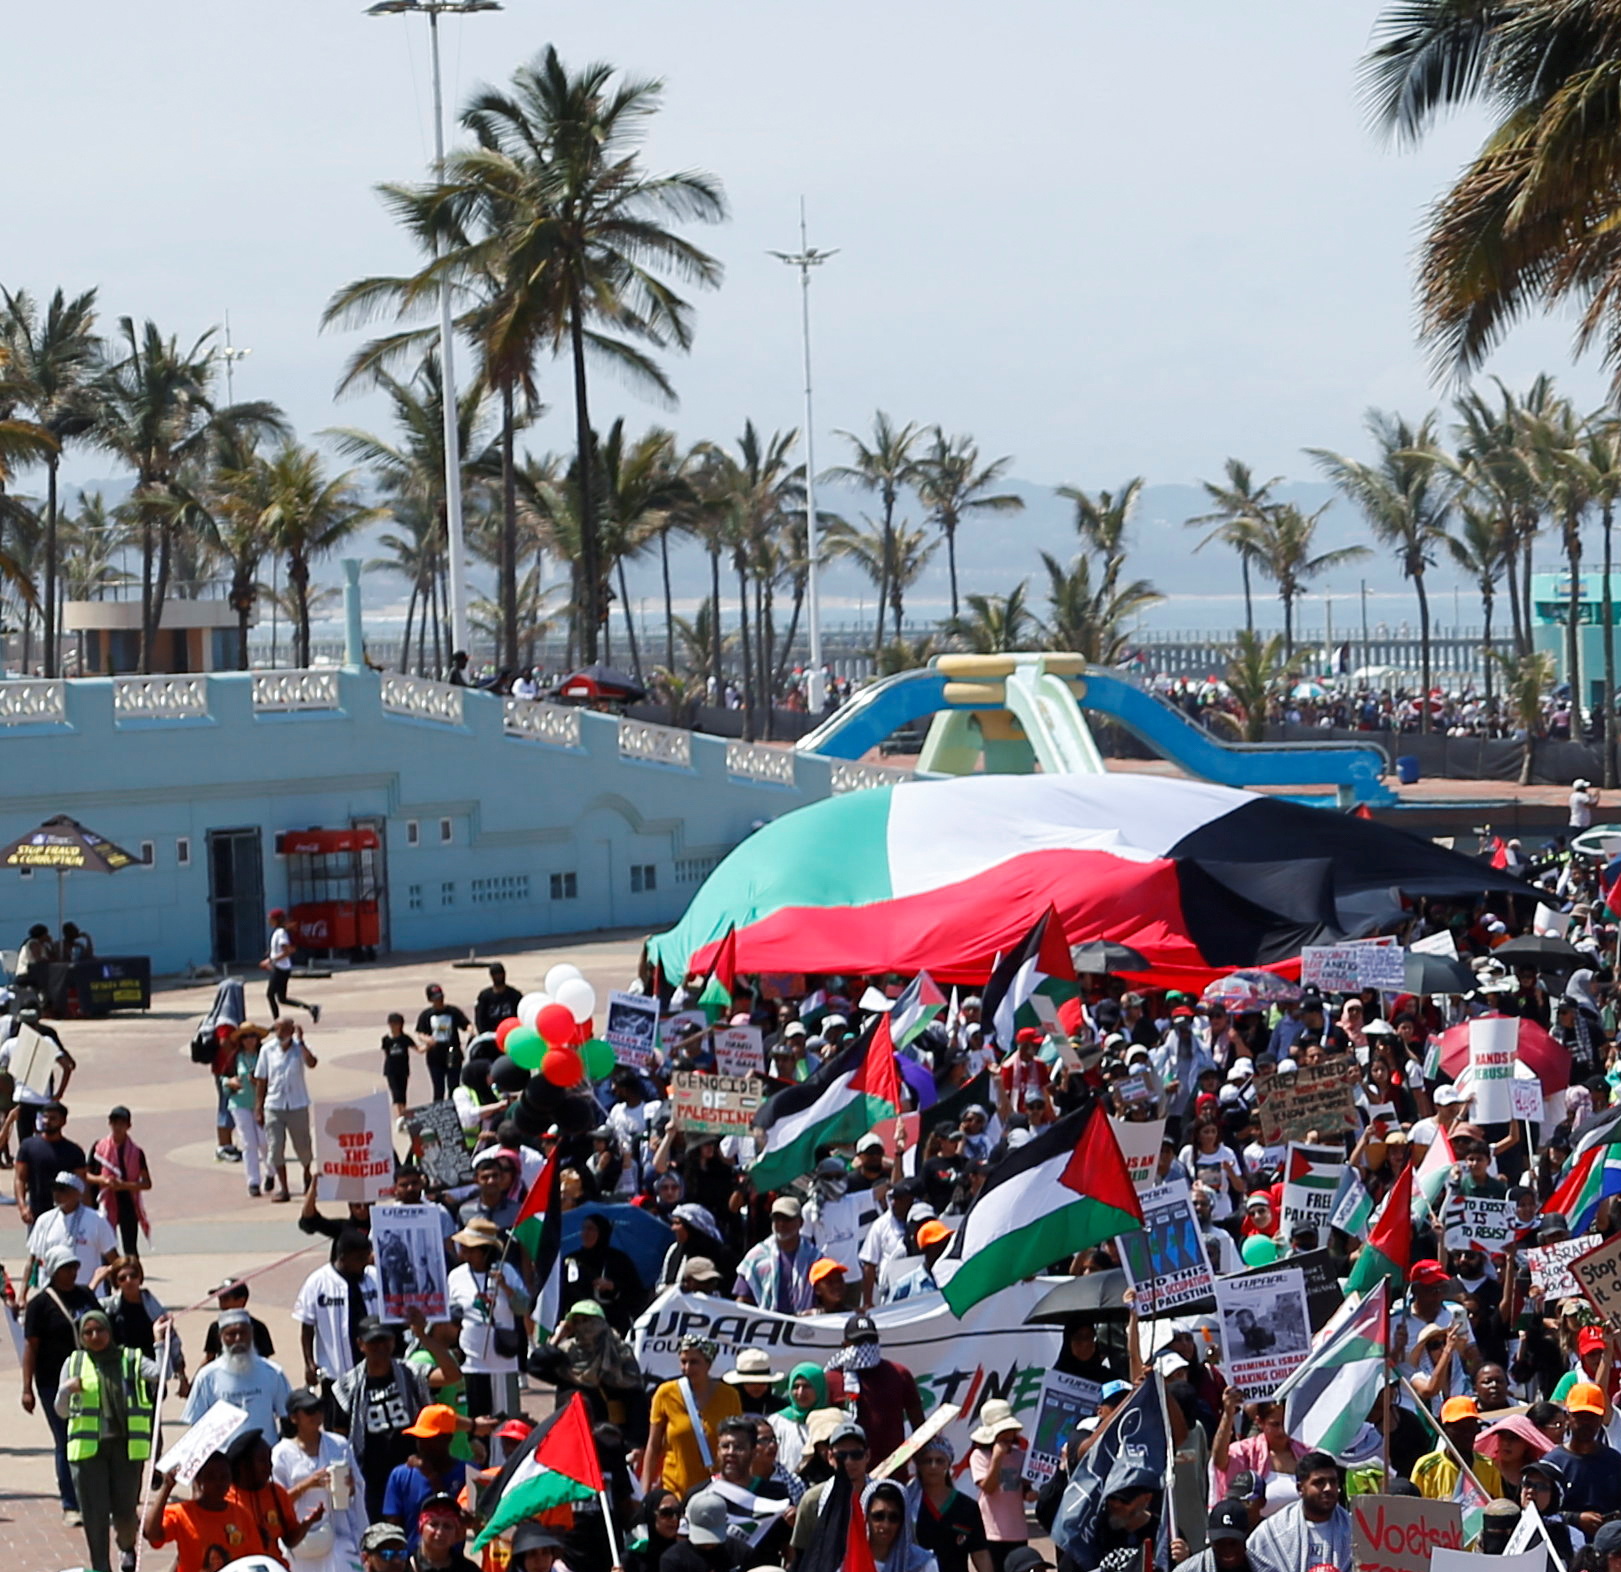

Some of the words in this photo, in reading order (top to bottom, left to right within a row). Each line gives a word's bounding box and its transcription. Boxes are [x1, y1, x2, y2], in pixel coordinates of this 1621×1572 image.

[676, 1075, 758, 1095] GENOCIDE
[702, 1090, 728, 1108] OF
[339, 1131, 374, 1146] STOP
[345, 1149, 371, 1162] THE
[323, 1159, 391, 1178] GENOCIDE
[1169, 1265, 1208, 1285] THIS
[1580, 1255, 1617, 1286] Stop
